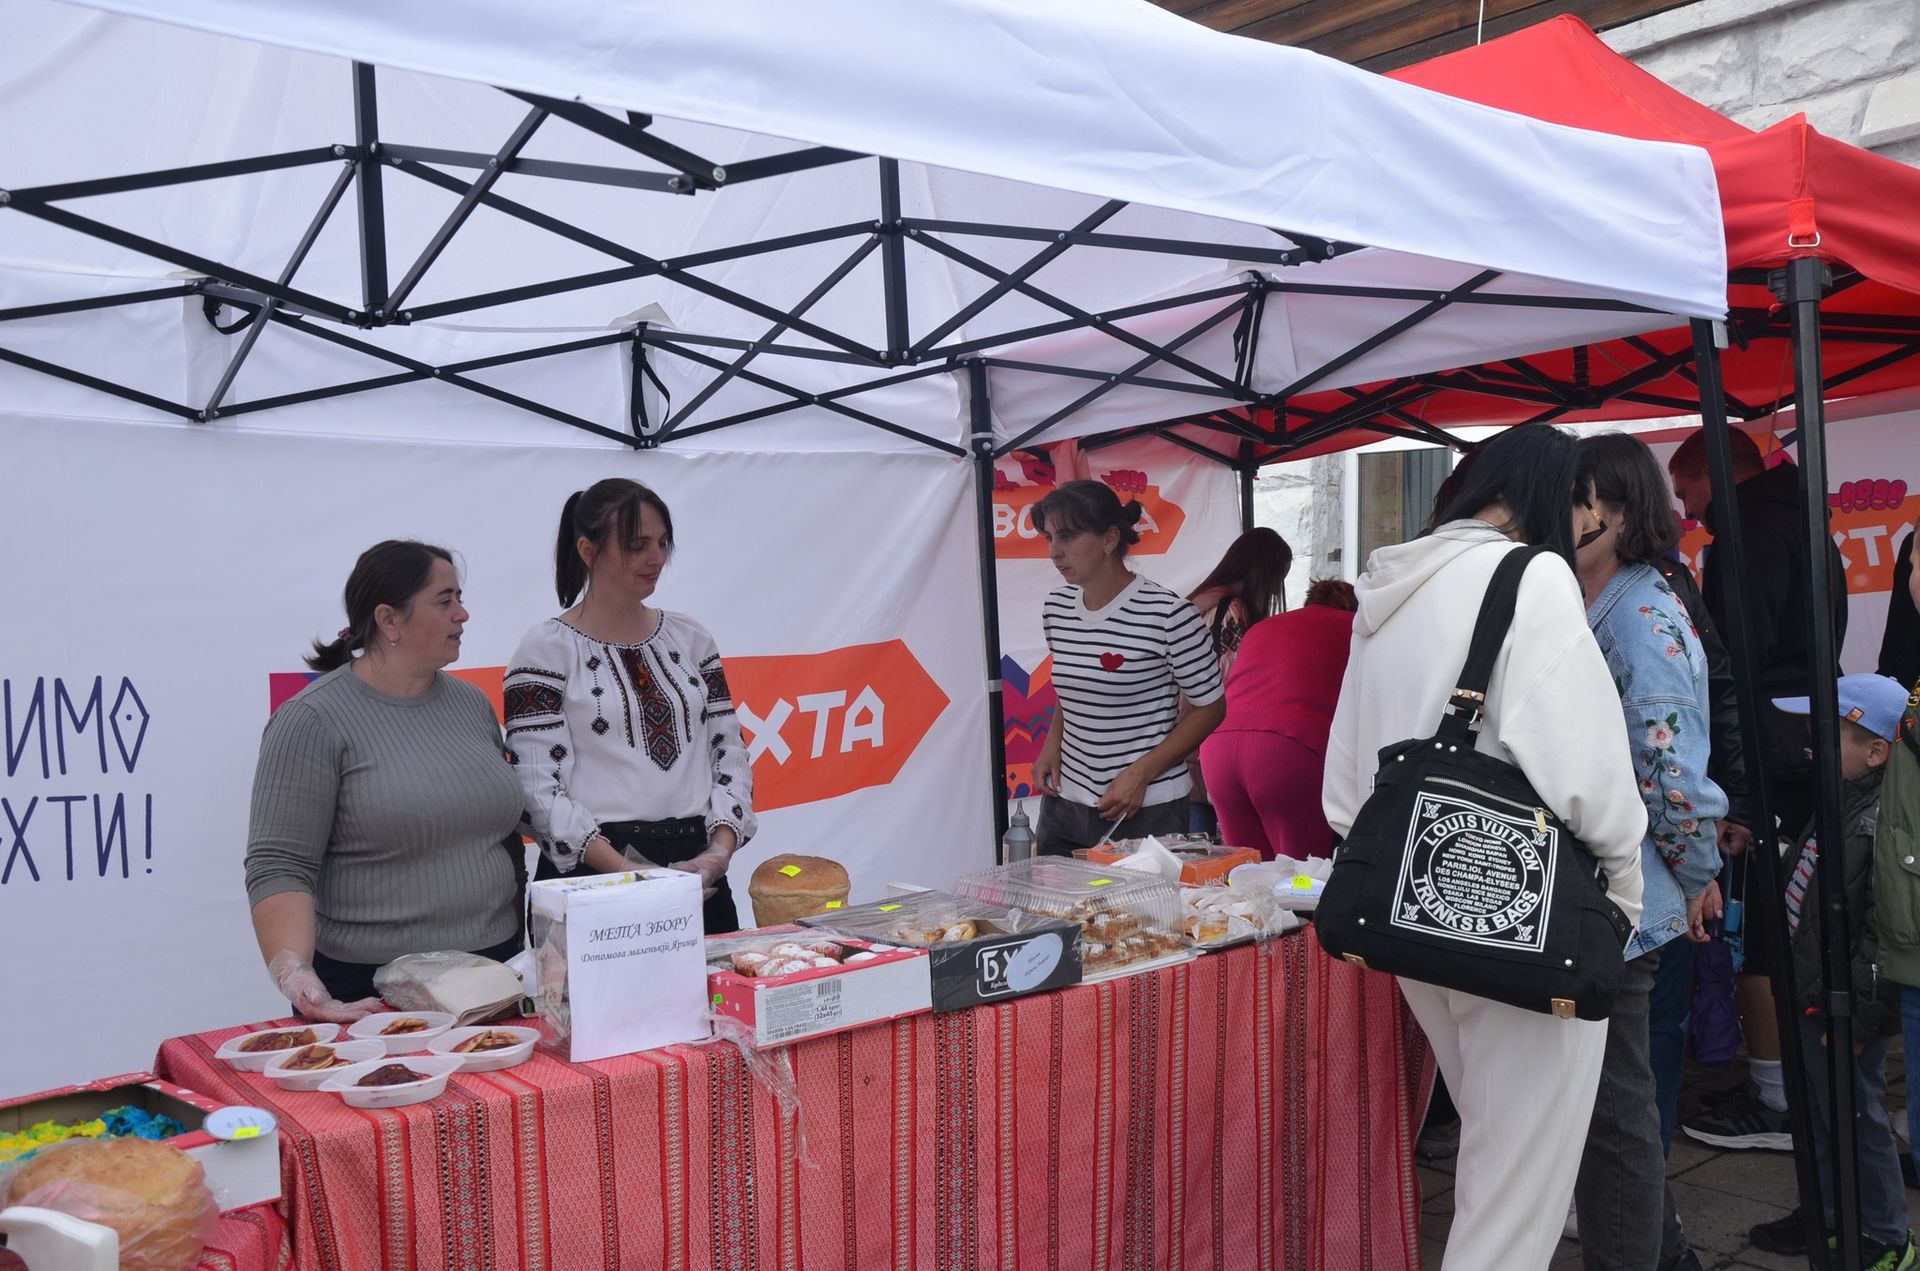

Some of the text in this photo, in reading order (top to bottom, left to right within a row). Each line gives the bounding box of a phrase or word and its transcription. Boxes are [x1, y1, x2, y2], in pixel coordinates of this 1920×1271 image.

[0, 792, 153, 884] ХТИ!
[1423, 814, 1540, 871] LOUIS VUITTON
[1458, 837, 1481, 847] LONDON
[1465, 832, 1483, 842] TOKYO
[1455, 842, 1485, 854] SHANGHAI
[1448, 847, 1512, 865] HONG KONG SYDNEY
[1457, 855, 1473, 863] YORK
[1435, 866, 1451, 876] DES
[1486, 870, 1517, 881] AVENUE
[1451, 879, 1480, 889] ANGELES
[1480, 884, 1511, 895] BANGKOK
[1443, 889, 1464, 897] OSAKA
[1481, 896, 1502, 905] VEGAS
[1445, 895, 1473, 905] MOSCOW
[1486, 892, 1510, 901] MEXICO
[1414, 874, 1539, 933] TRUNKS & BAGS
[1454, 903, 1487, 914] FLORENCE
[589, 914, 694, 942] МЕТА ЗБОРУ
[581, 950, 626, 963] Допомога
